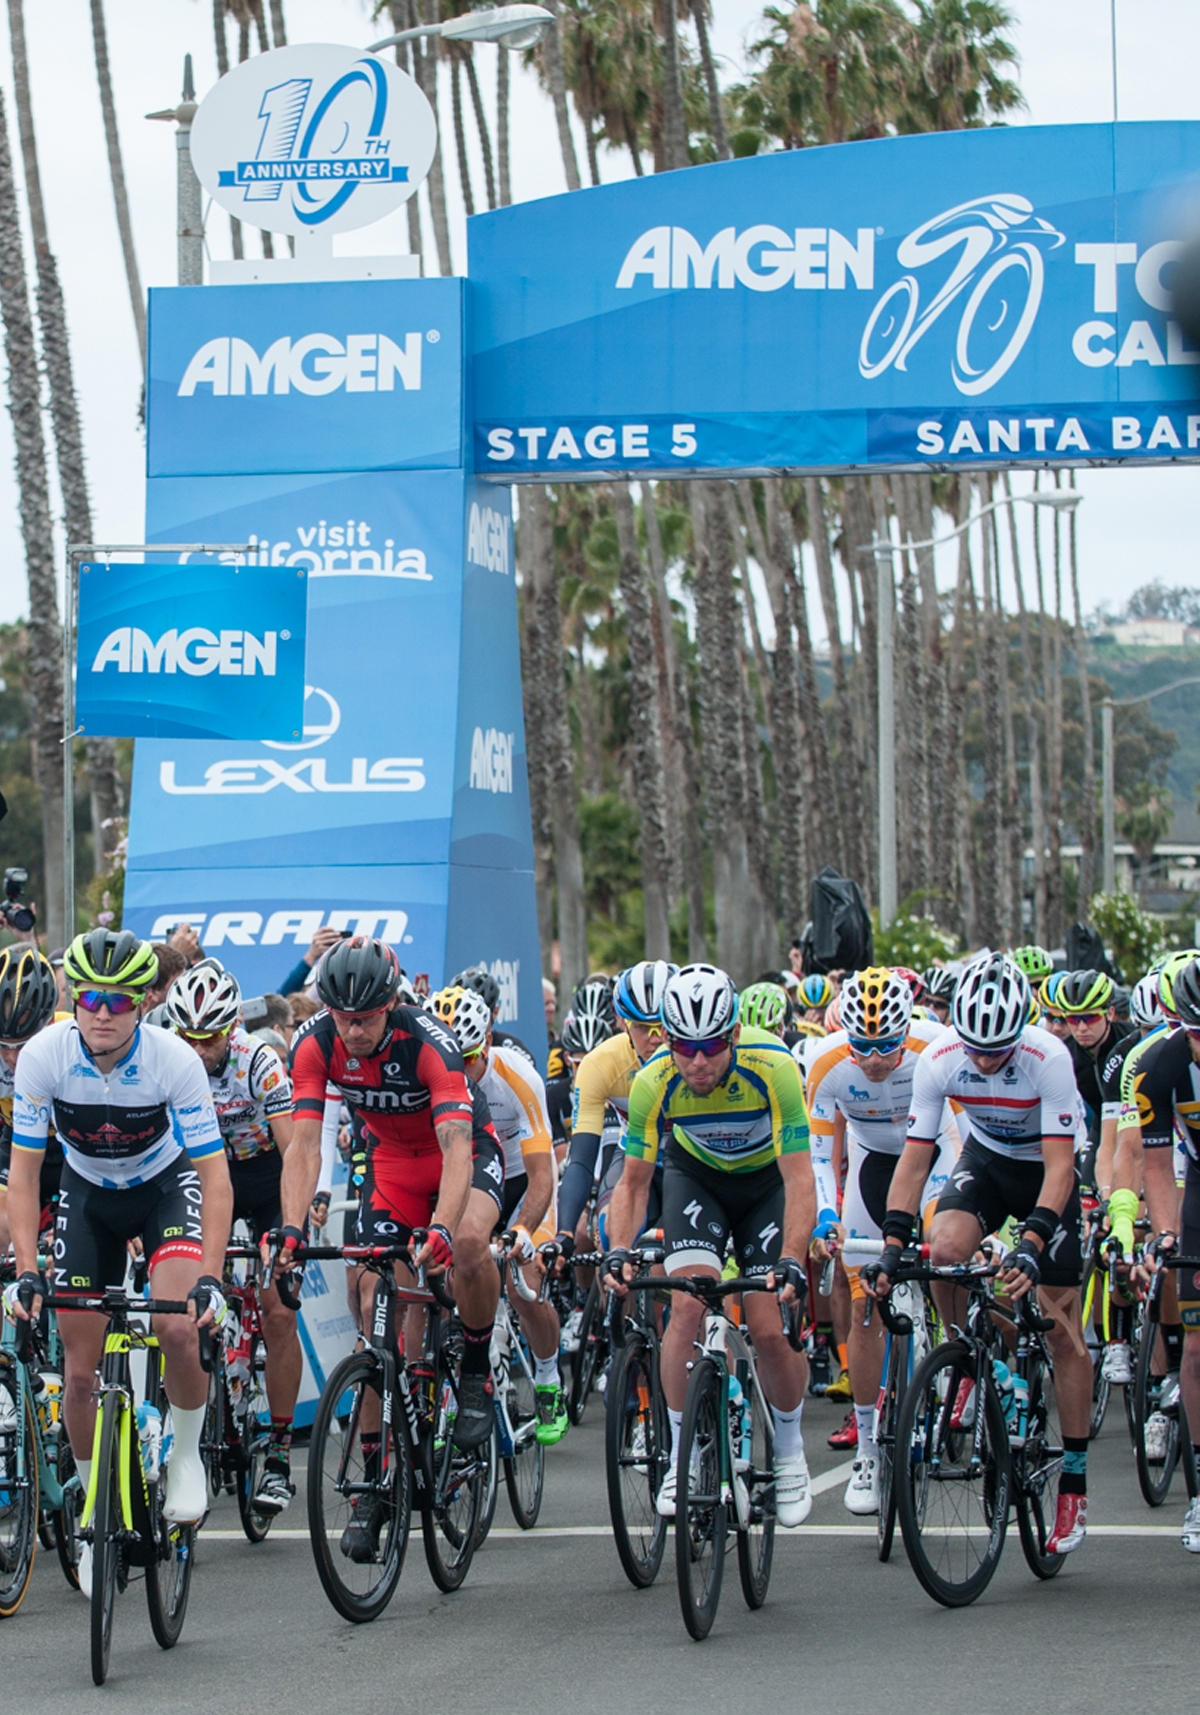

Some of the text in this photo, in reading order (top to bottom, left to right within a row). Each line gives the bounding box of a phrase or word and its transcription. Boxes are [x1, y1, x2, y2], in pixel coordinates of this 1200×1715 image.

[242, 159, 386, 181] ANNIVERSARY
[487, 423, 697, 461] STAGE 5
[916, 417, 1081, 456] SANTA
[297, 519, 371, 548] visit
[160, 756, 427, 796] LEXUS
[415, 1015, 461, 1054] BMC
[336, 1084, 431, 1109] BMC
[373, 1293, 389, 1338] BMC
[382, 1389, 393, 1425] BMC
